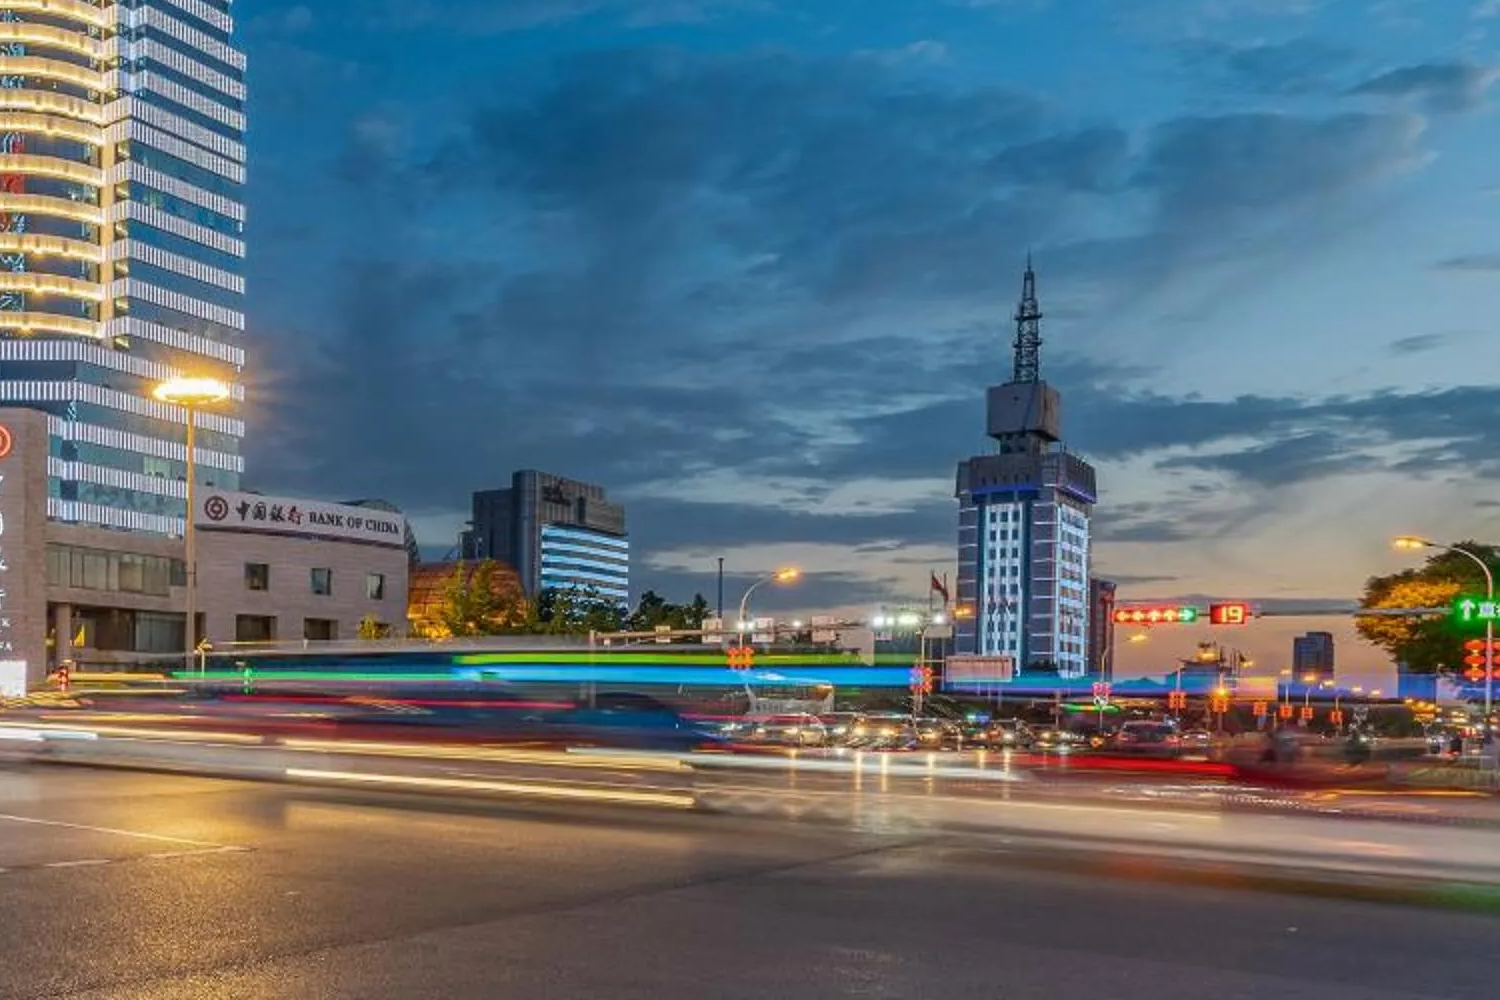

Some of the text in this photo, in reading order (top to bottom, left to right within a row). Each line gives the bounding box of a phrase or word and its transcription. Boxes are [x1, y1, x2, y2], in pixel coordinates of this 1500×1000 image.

[308, 511, 400, 535] BANK OF CHINA
[1220, 605, 1244, 624] 19
